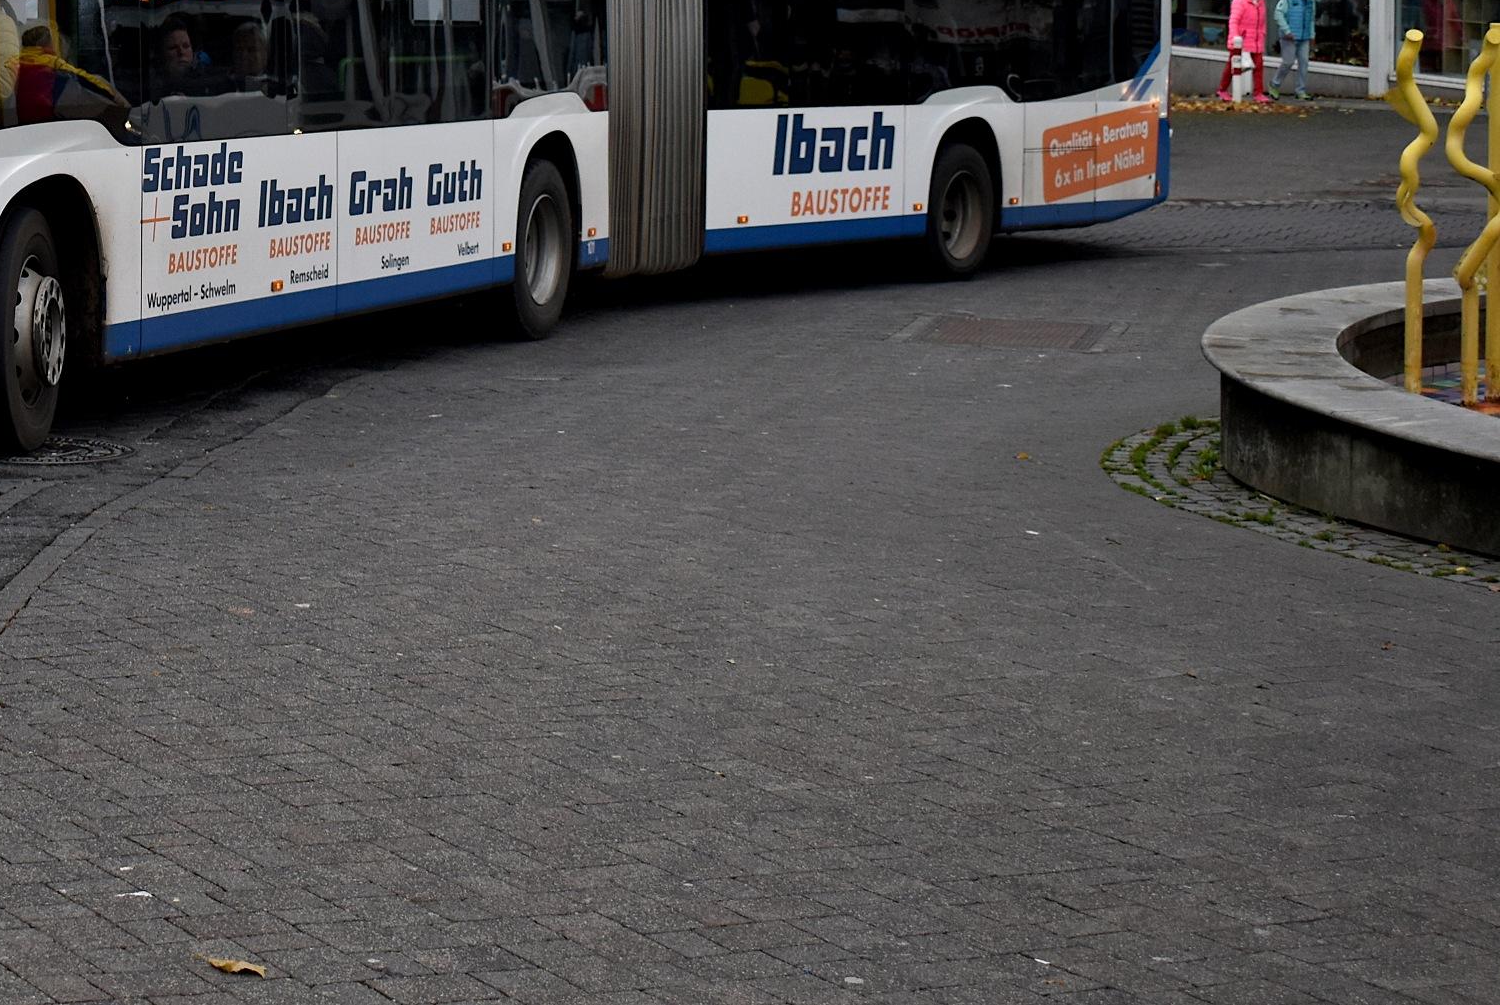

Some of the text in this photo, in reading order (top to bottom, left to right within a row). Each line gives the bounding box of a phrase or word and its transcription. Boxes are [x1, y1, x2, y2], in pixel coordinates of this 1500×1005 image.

[772, 111, 895, 176] Ibach
[1049, 130, 1093, 158] Qualität
[1102, 120, 1149, 145] Beratung
[142, 142, 244, 193] Schade
[427, 159, 483, 207] Guth
[1054, 146, 1146, 188] 6x in Ihrer Nähe!
[258, 174, 334, 228] Ibach
[349, 166, 413, 217] Grah
[791, 186, 891, 217] BAUSTOFFE
[171, 191, 241, 240] Sohn
[430, 211, 481, 235] BAUSTOFFE
[269, 231, 331, 259] BAUSTOFFE
[355, 221, 411, 246] BAUSTOFFE
[457, 241, 479, 257] Velbert
[168, 244, 238, 275] BAUSTOFFE
[290, 263, 329, 285] Remscheid
[381, 253, 410, 271] Solingen
[147, 289, 192, 312] Wuppertal
[200, 279, 236, 301] Schwelm
